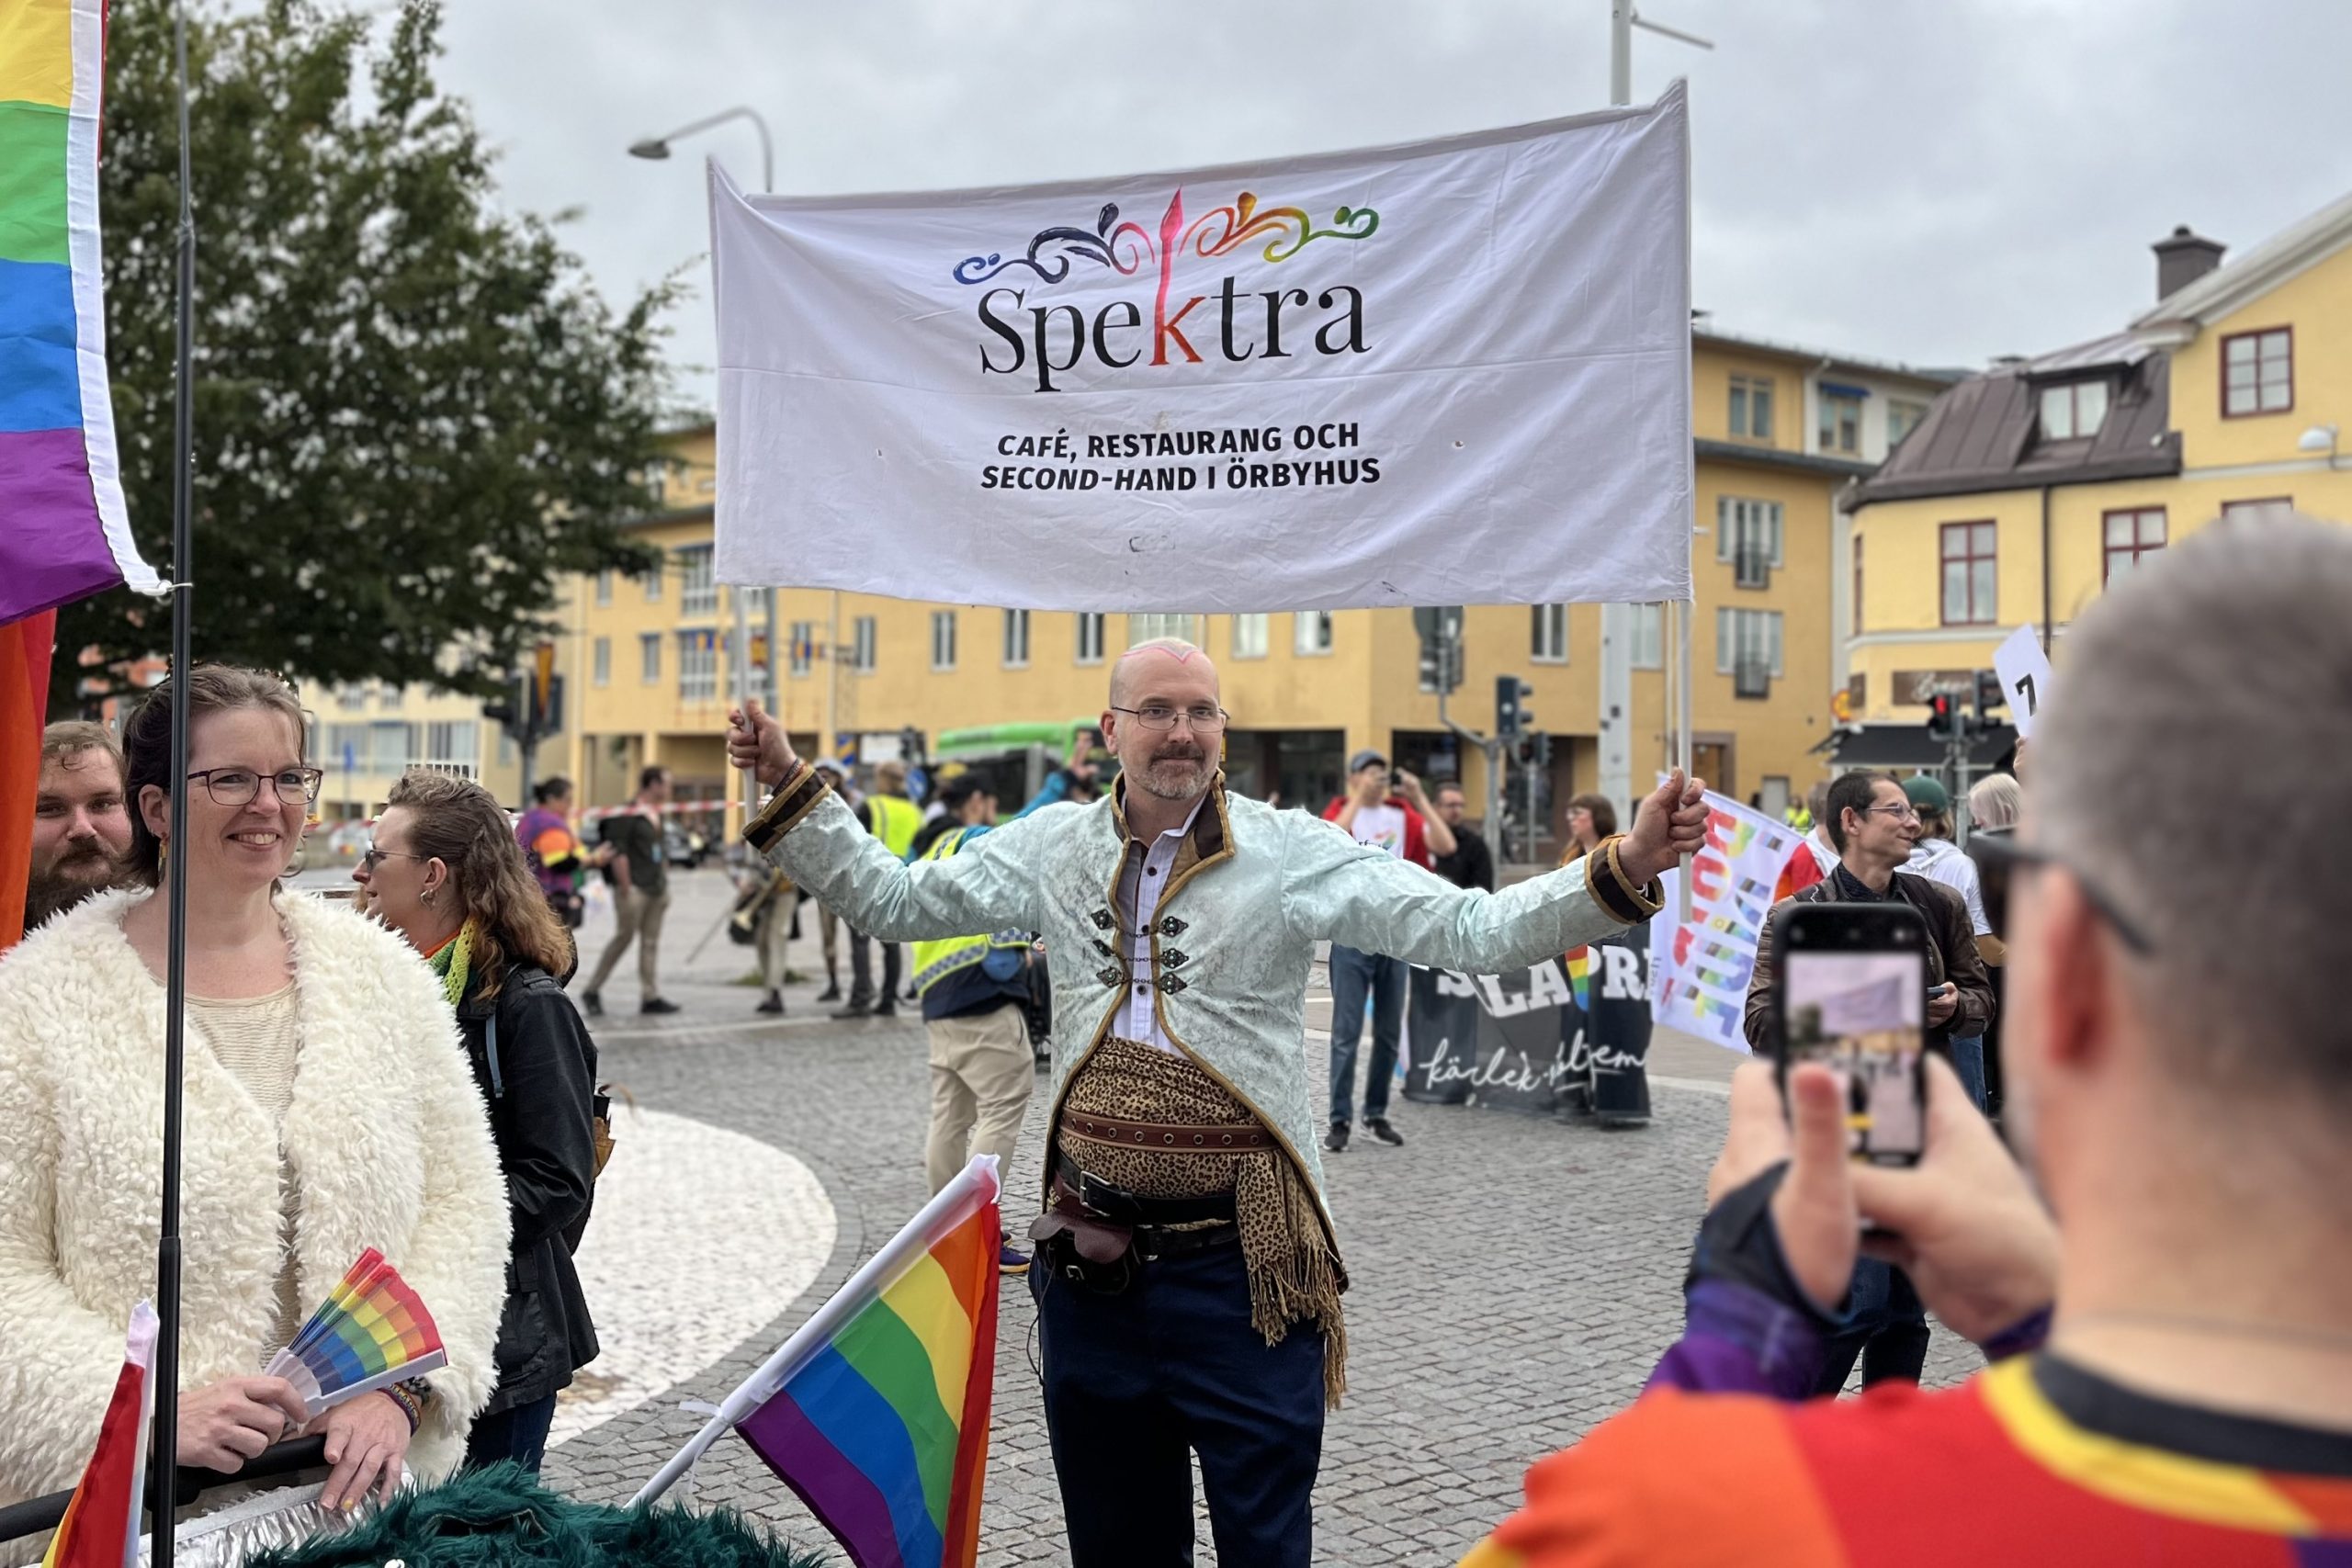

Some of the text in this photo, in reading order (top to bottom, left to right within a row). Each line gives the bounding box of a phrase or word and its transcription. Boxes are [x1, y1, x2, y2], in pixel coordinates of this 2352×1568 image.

[978, 241, 1373, 393] Spektra
[998, 422, 1359, 464] CAFÉ, RESTAURANG OCH
[980, 457, 1381, 491] SECOND-HAND I ÖRBYHUS
